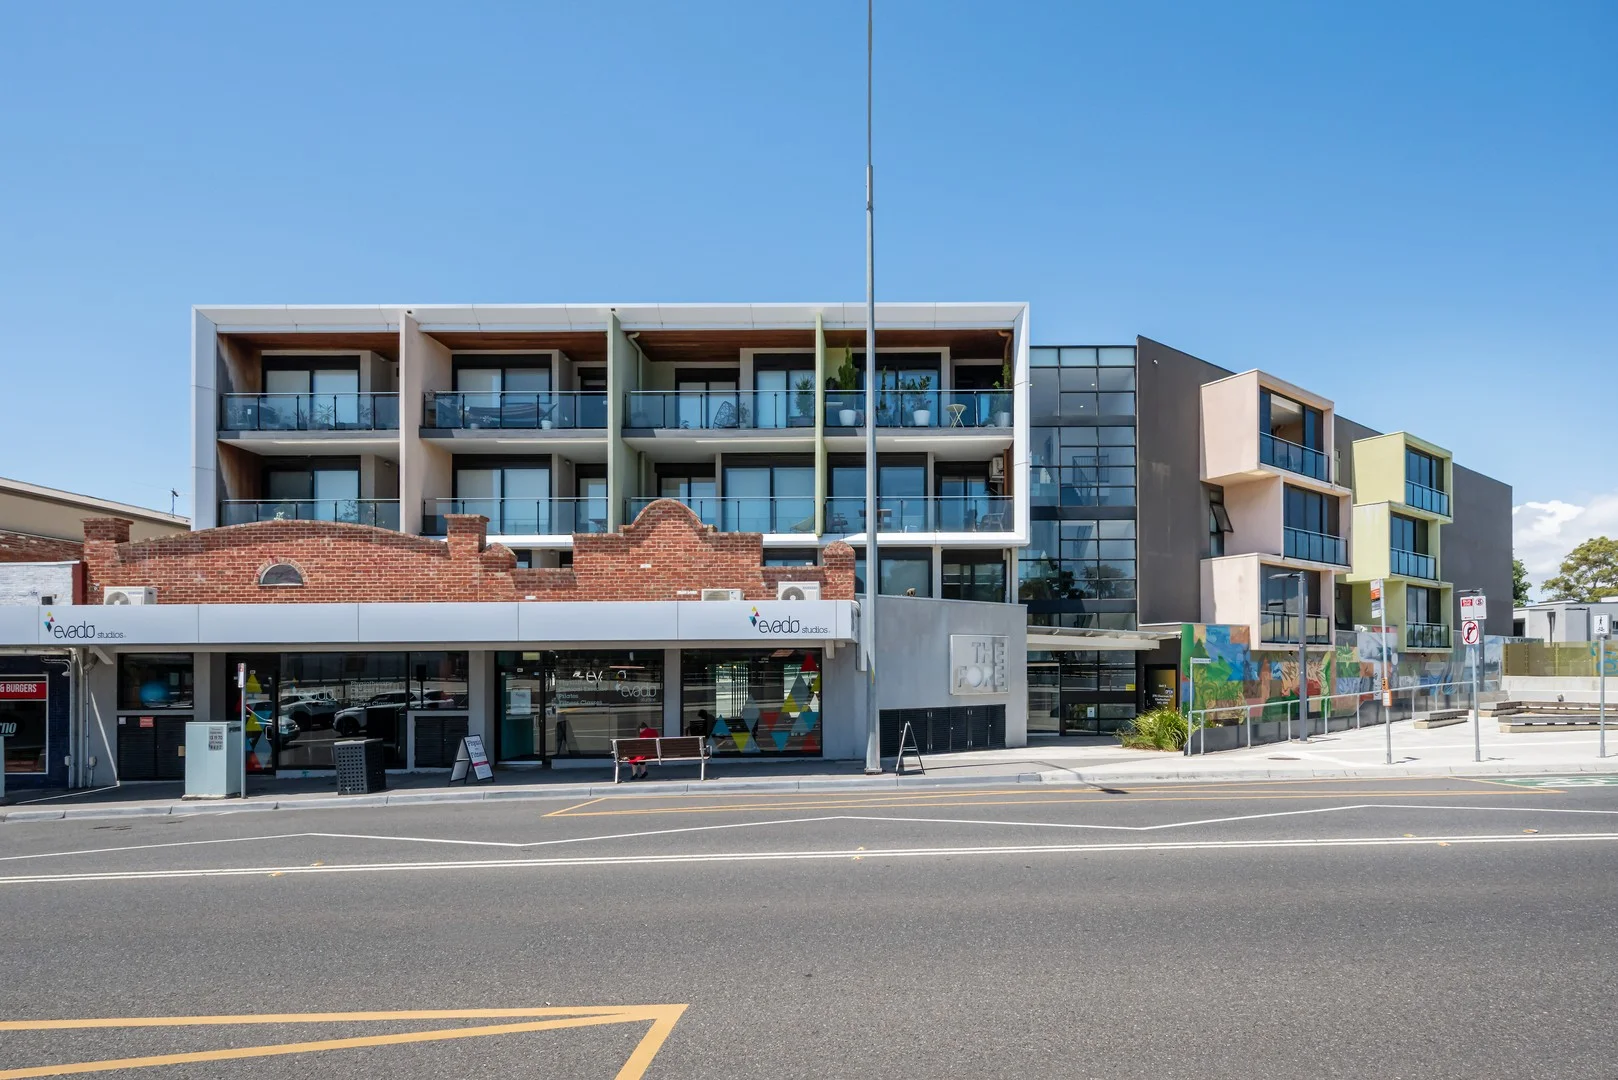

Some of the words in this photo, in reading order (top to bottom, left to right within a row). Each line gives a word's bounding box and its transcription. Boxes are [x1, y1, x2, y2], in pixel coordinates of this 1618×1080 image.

[54, 621, 95, 638] evado
[759, 616, 800, 633] evado
[801, 626, 828, 634] studios
[971, 642, 1005, 664] THE
[958, 665, 1005, 688] FORE
[6, 683, 37, 693] BURGERS
